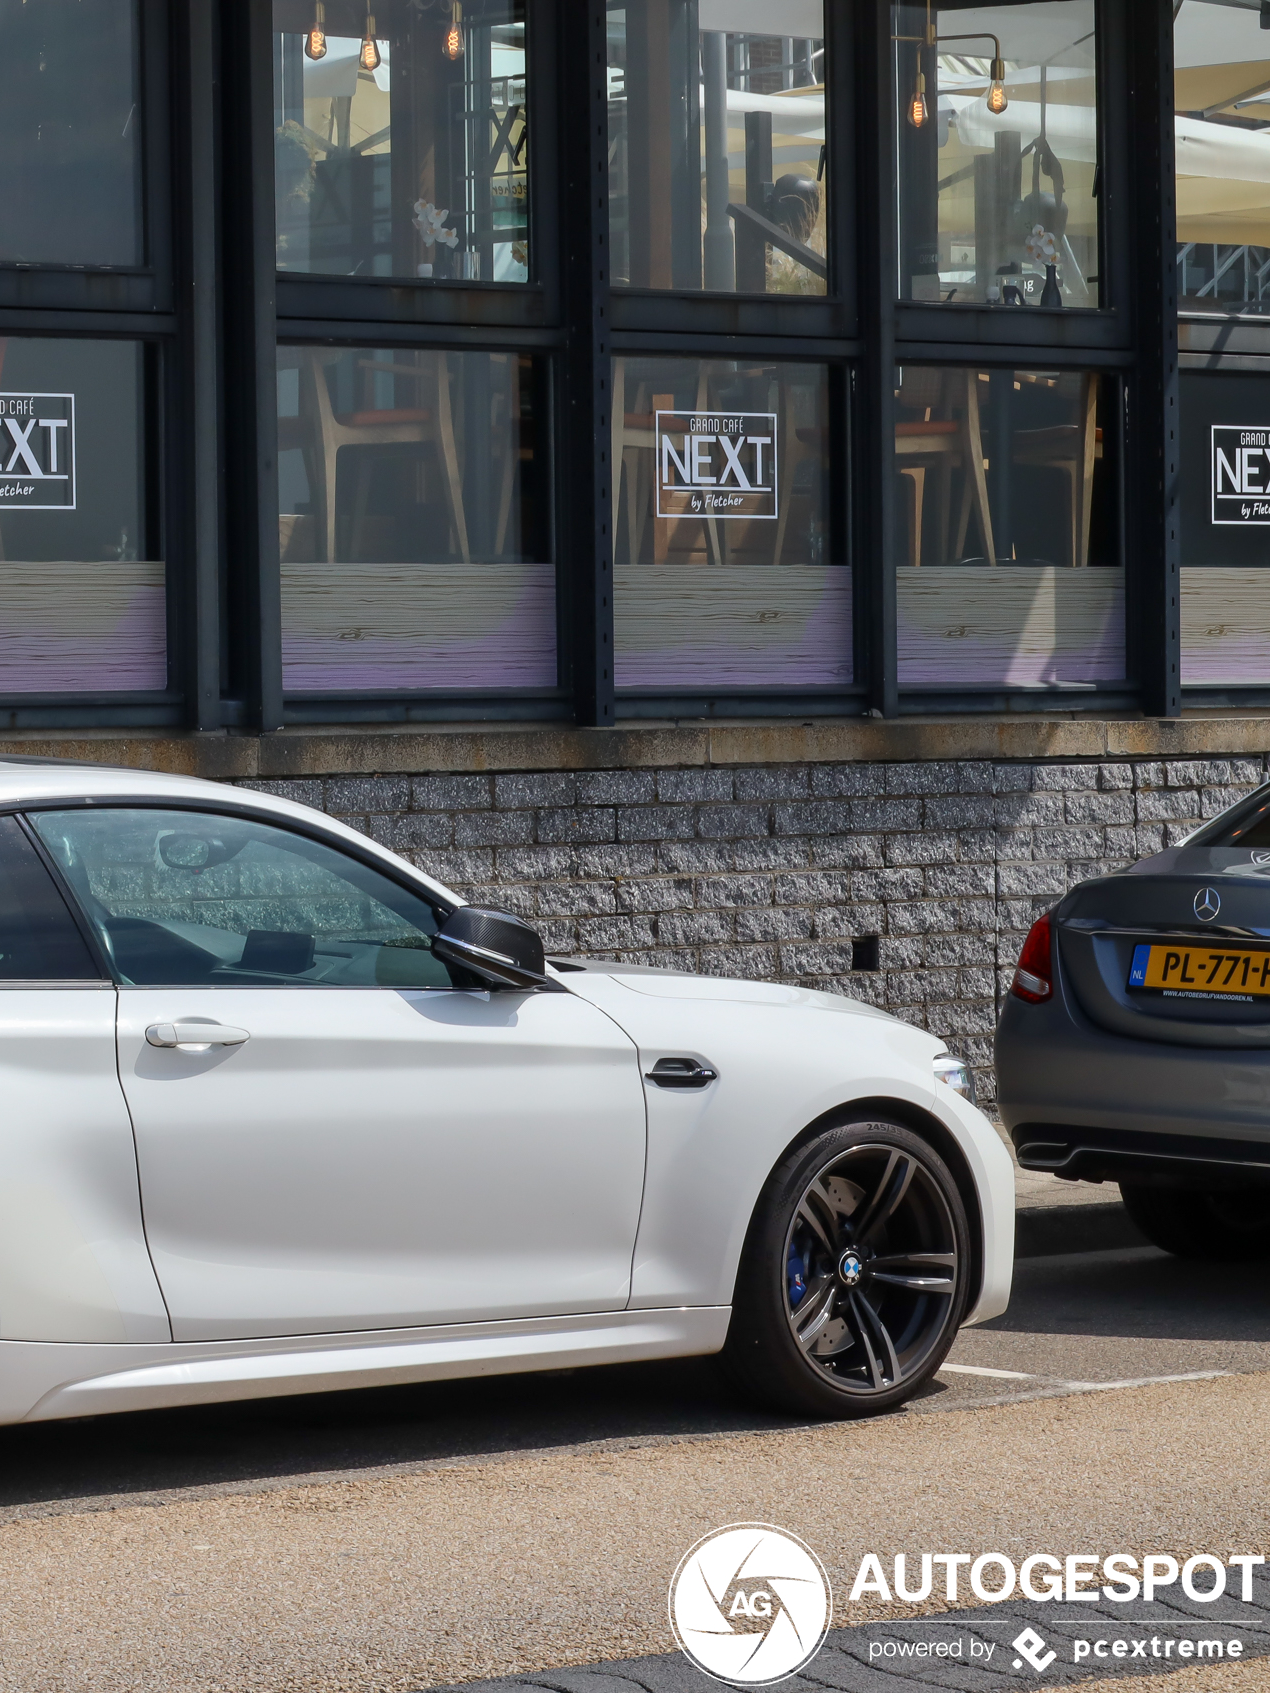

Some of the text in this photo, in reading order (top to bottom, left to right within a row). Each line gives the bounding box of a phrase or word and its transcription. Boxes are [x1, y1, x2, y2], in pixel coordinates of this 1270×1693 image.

[9, 397, 34, 415] CAFÉ
[690, 416, 743, 433] GRAND CAFÉ
[1240, 432, 1266, 446] GRAND
[662, 434, 771, 487] NEXT
[691, 493, 744, 512] by Fletcher
[1241, 503, 1251, 519] by
[1132, 970, 1143, 980] NL
[866, 1123, 903, 1135] 245/35
